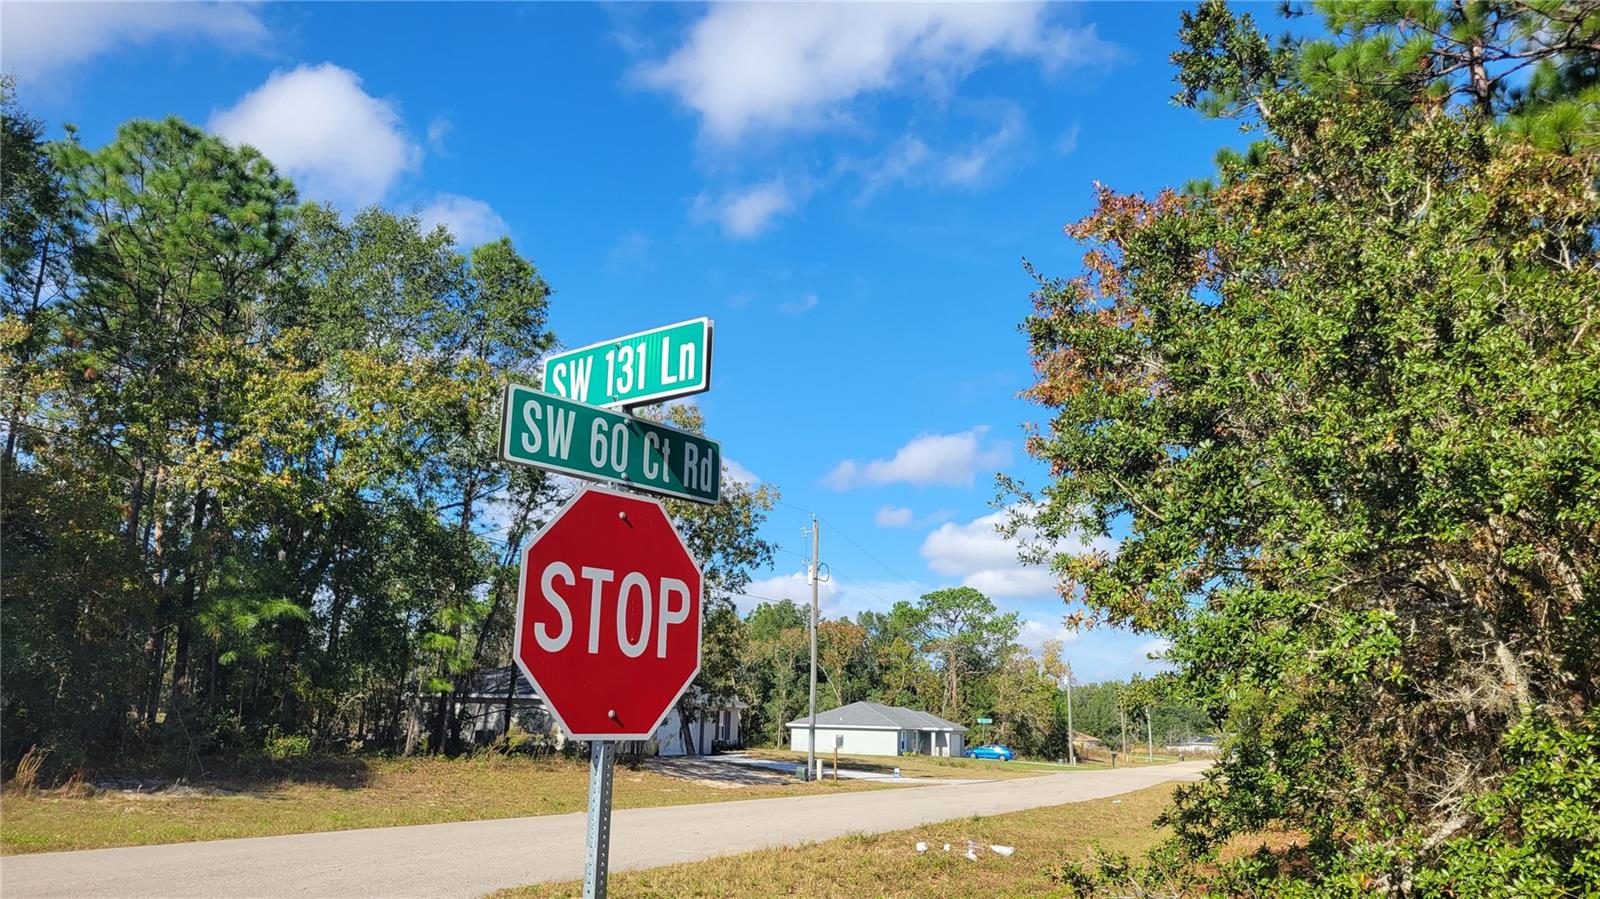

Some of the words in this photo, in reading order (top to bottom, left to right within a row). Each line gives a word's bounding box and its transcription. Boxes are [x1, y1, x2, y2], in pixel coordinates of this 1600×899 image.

[552, 355, 593, 403] SW
[605, 341, 647, 396] 131
[660, 336, 695, 385] Ln
[521, 399, 576, 460] SW
[590, 417, 629, 473] 60
[643, 431, 671, 483] Ct
[683, 442, 713, 493] Rd
[533, 560, 691, 659] STOP
